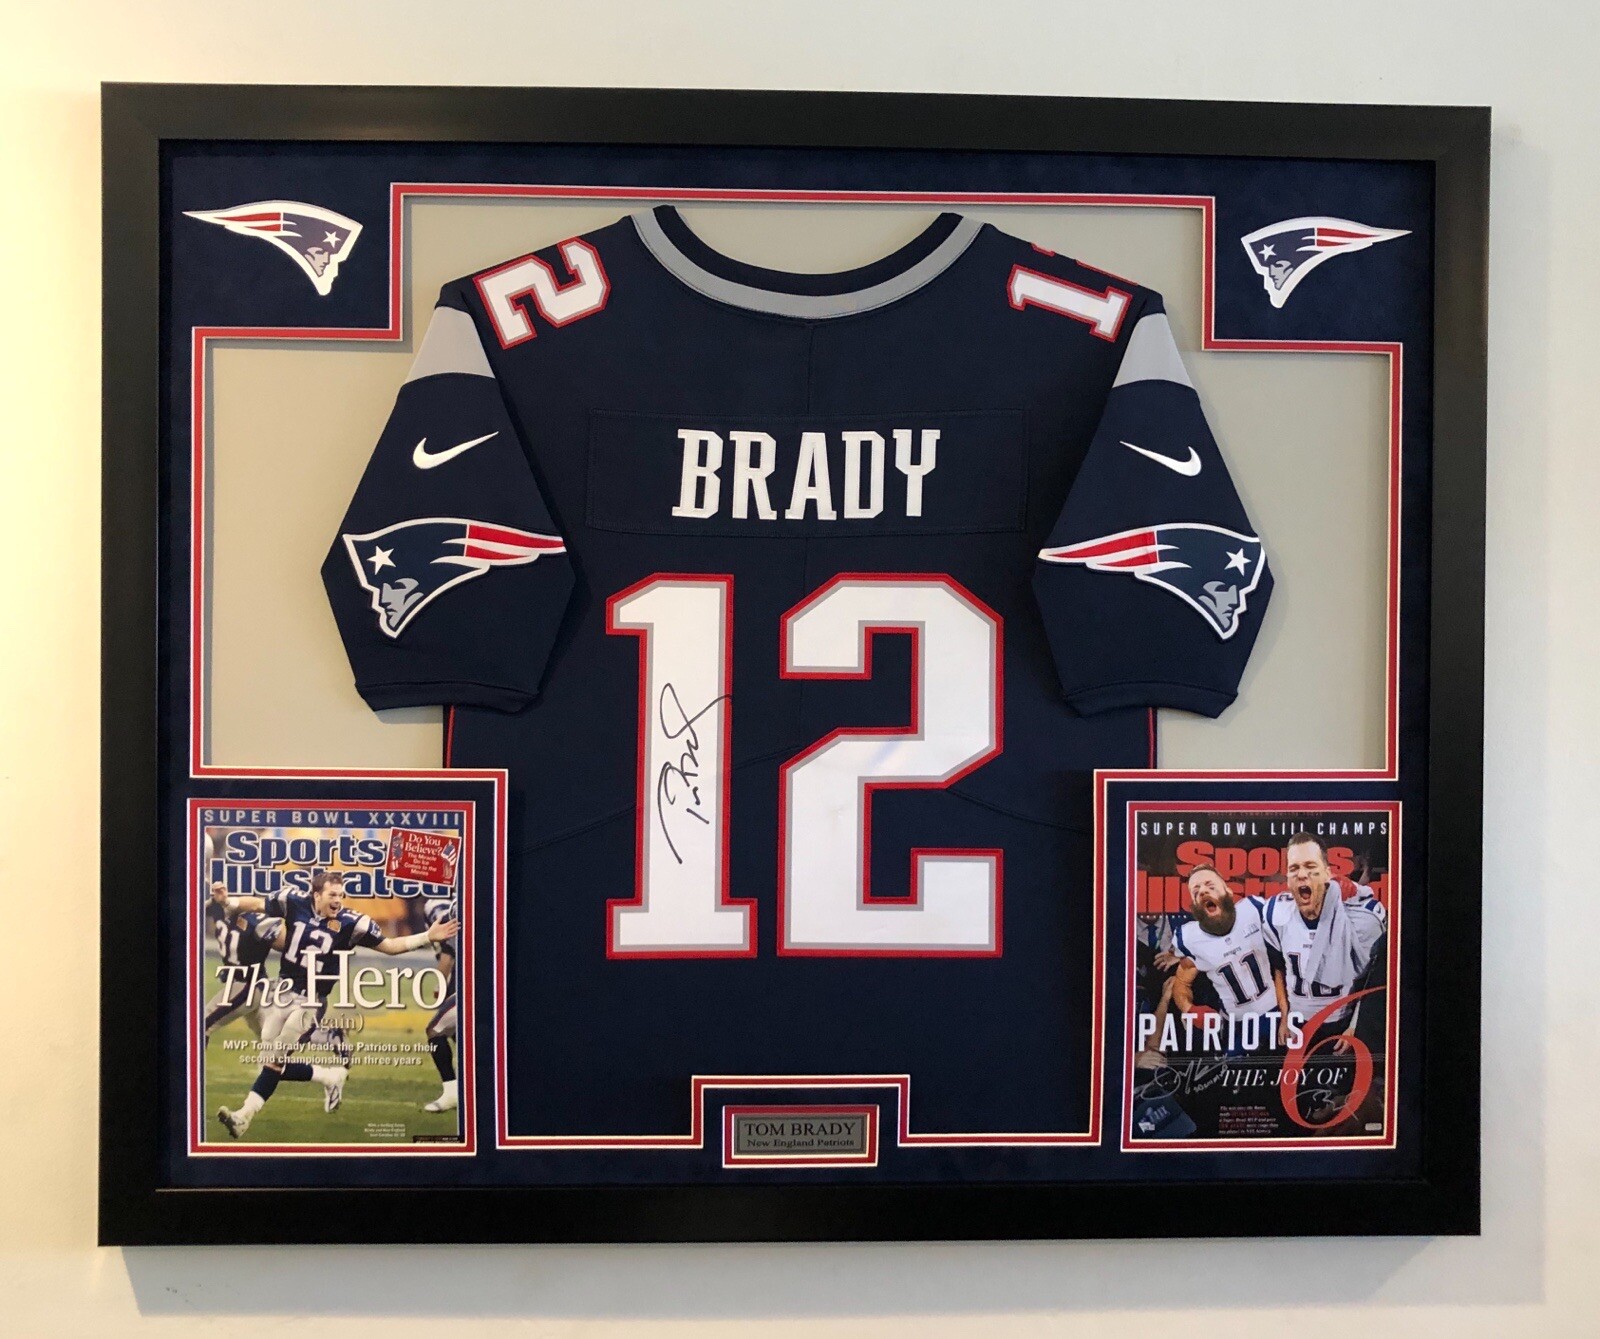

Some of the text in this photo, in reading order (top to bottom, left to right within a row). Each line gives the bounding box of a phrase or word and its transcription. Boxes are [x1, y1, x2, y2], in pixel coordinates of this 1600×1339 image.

[672, 428, 941, 521] BRADY
[606, 572, 1004, 960] 12
[204, 809, 459, 826] SUPER BOWL XXXVIII
[1140, 821, 1198, 836] SUPER
[1211, 821, 1258, 836] BOWL
[1317, 821, 1388, 835] CHAMPS
[226, 830, 386, 868] Sports
[404, 841, 443, 856] Believe?
[408, 833, 441, 846] Do You
[215, 949, 448, 1009] The Hero
[1215, 949, 1270, 1008] 11
[301, 1013, 364, 1032] (Again)
[1138, 1011, 1305, 1052] PATRIOTS
[222, 1039, 439, 1053] MVP Tom Brady leads the Patriots to their
[239, 1054, 422, 1068] second championship in three years
[1279, 985, 1387, 1129] 6
[1222, 1069, 1267, 1087] THE
[1270, 1068, 1315, 1087] JOY
[1316, 1067, 1349, 1086] OF
[744, 1122, 856, 1136] TOM BRADY
[747, 1138, 855, 1149] New England Patriots
